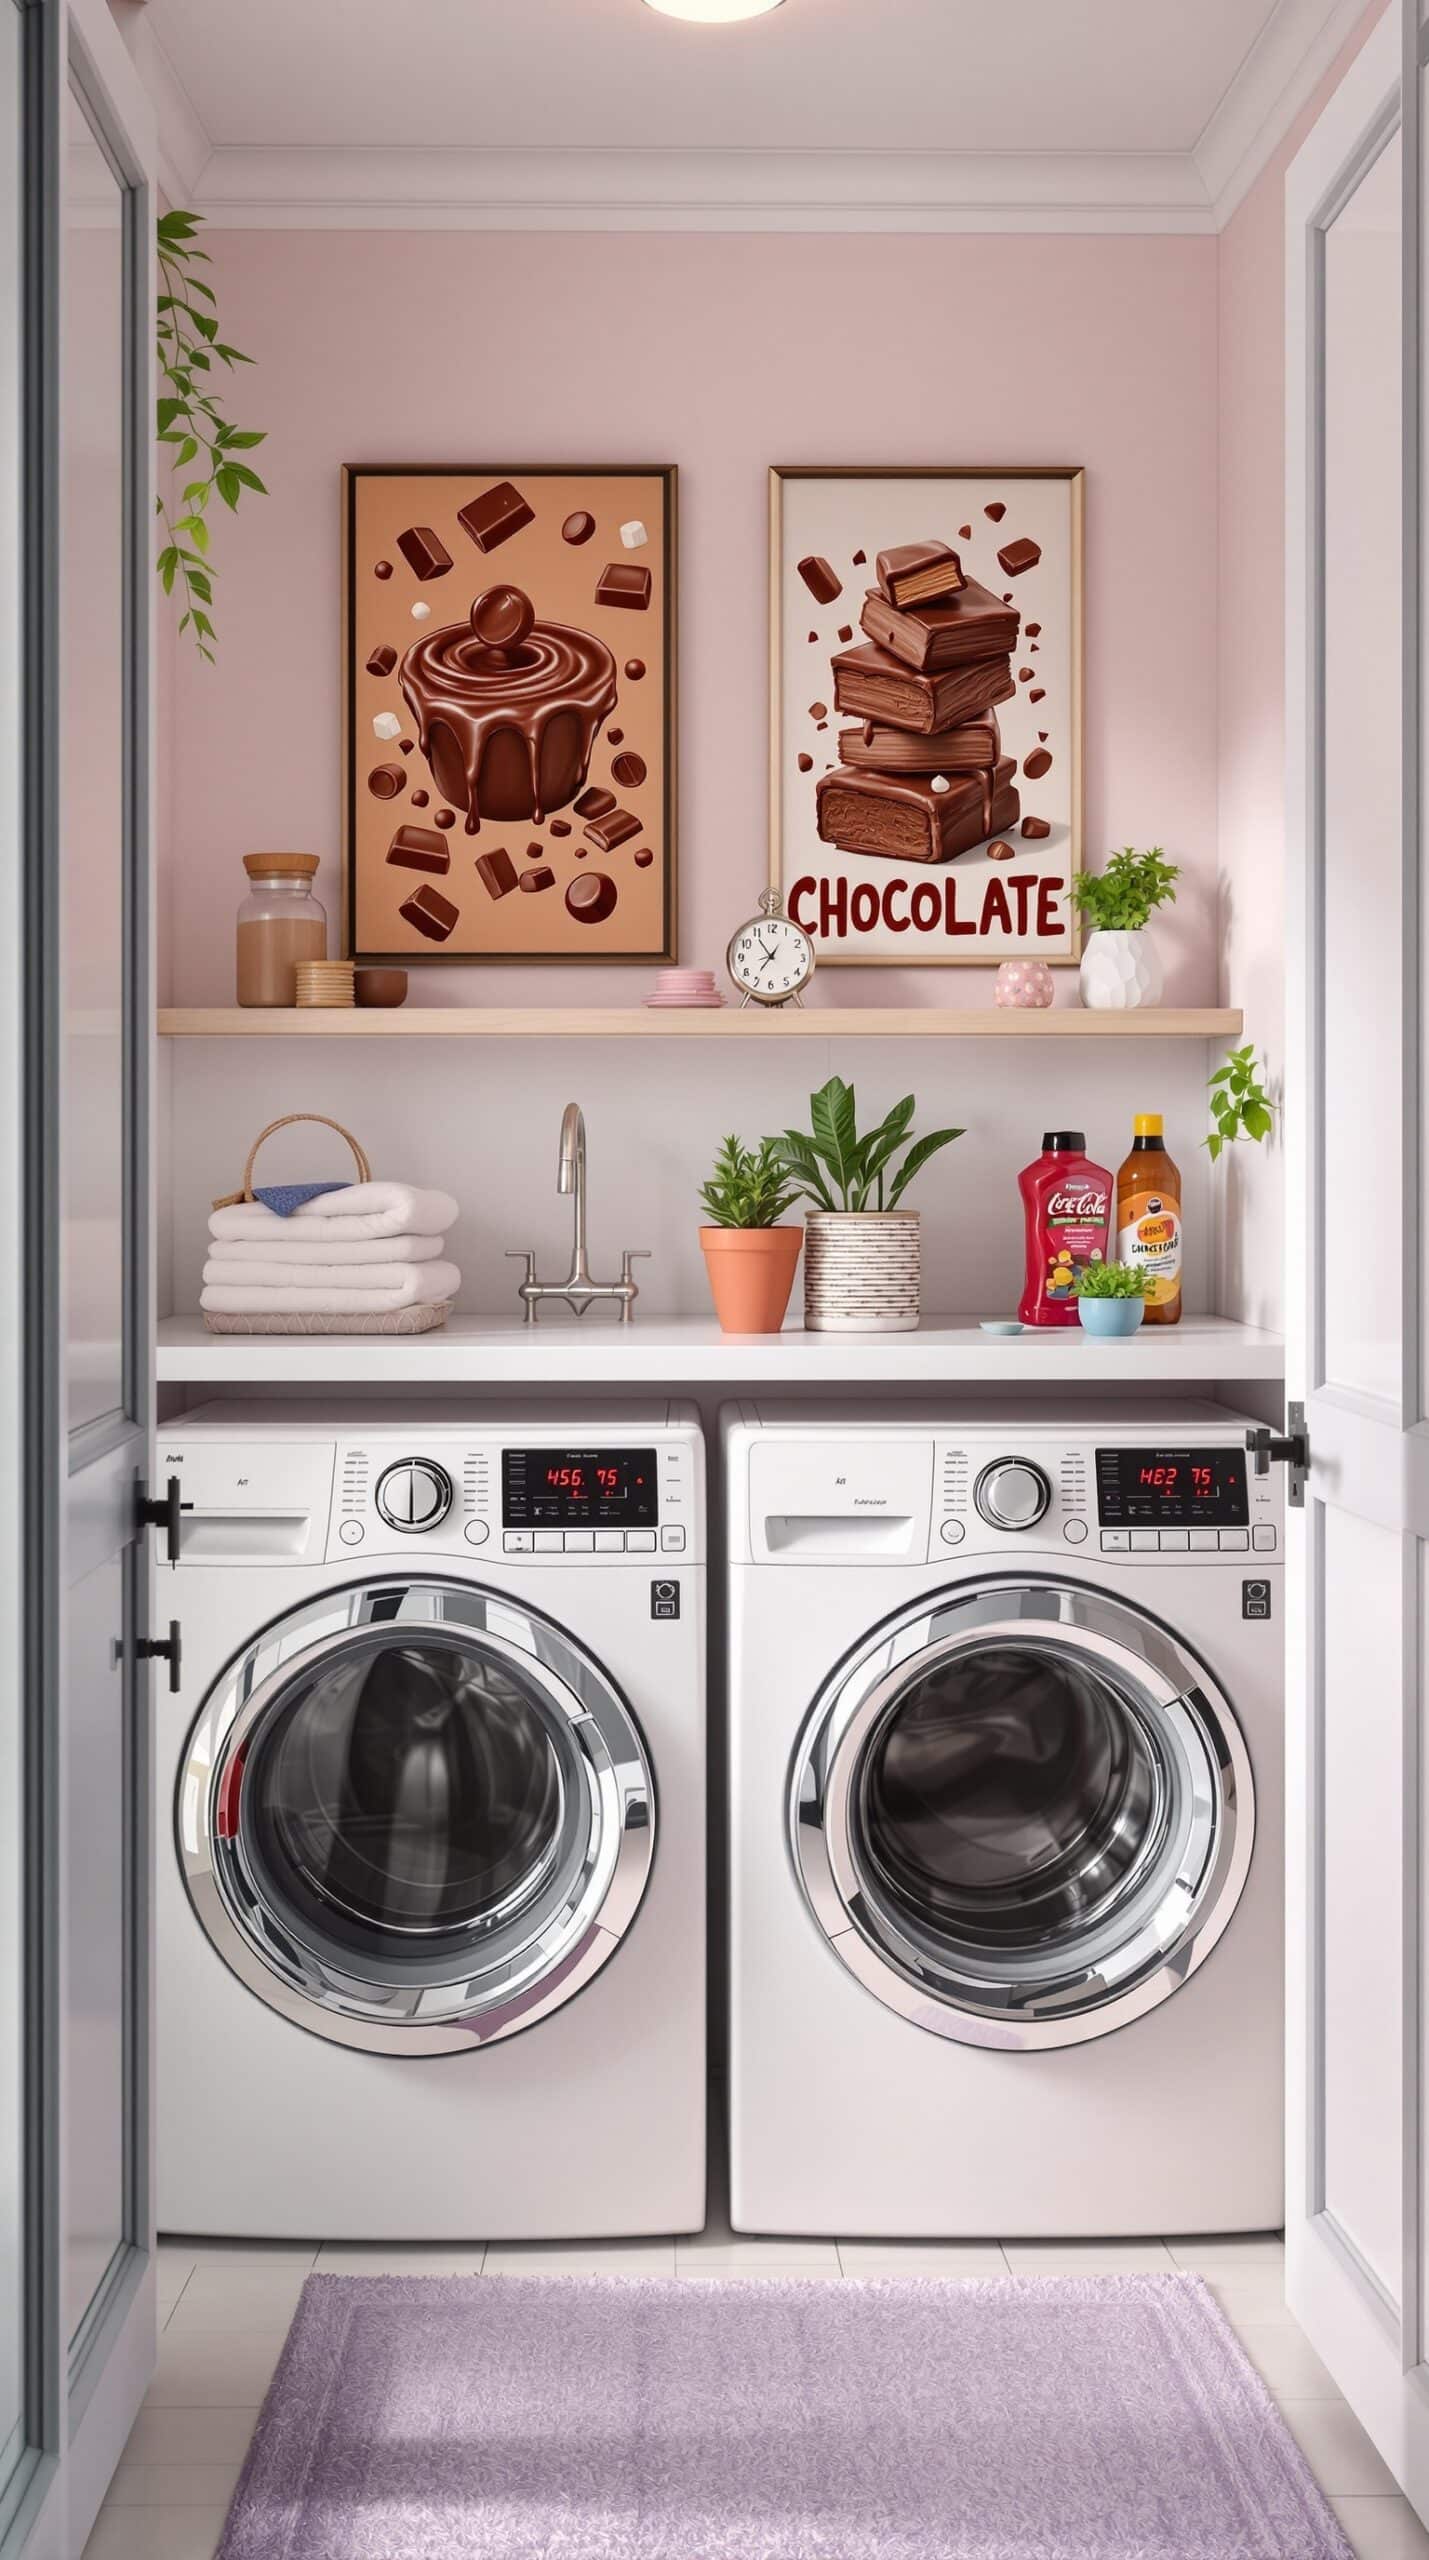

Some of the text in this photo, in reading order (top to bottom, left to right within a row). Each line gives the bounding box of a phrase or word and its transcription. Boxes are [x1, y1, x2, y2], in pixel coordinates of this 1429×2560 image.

[788, 875, 1065, 937] CHOCOLATE
[753, 927, 761, 938] 11
[767, 923, 778, 934] 12
[742, 938, 752, 950] 10
[793, 938, 801, 949] 2
[737, 953, 745, 963] 9
[799, 953, 806, 963] 3
[743, 967, 750, 977] 8
[793, 967, 801, 977] 4
[753, 976, 760, 988] 7
[767, 979, 775, 990] 6
[783, 976, 790, 986] 5
[597, 1468, 617, 1486] 75
[1191, 1467, 1212, 1486] 75
